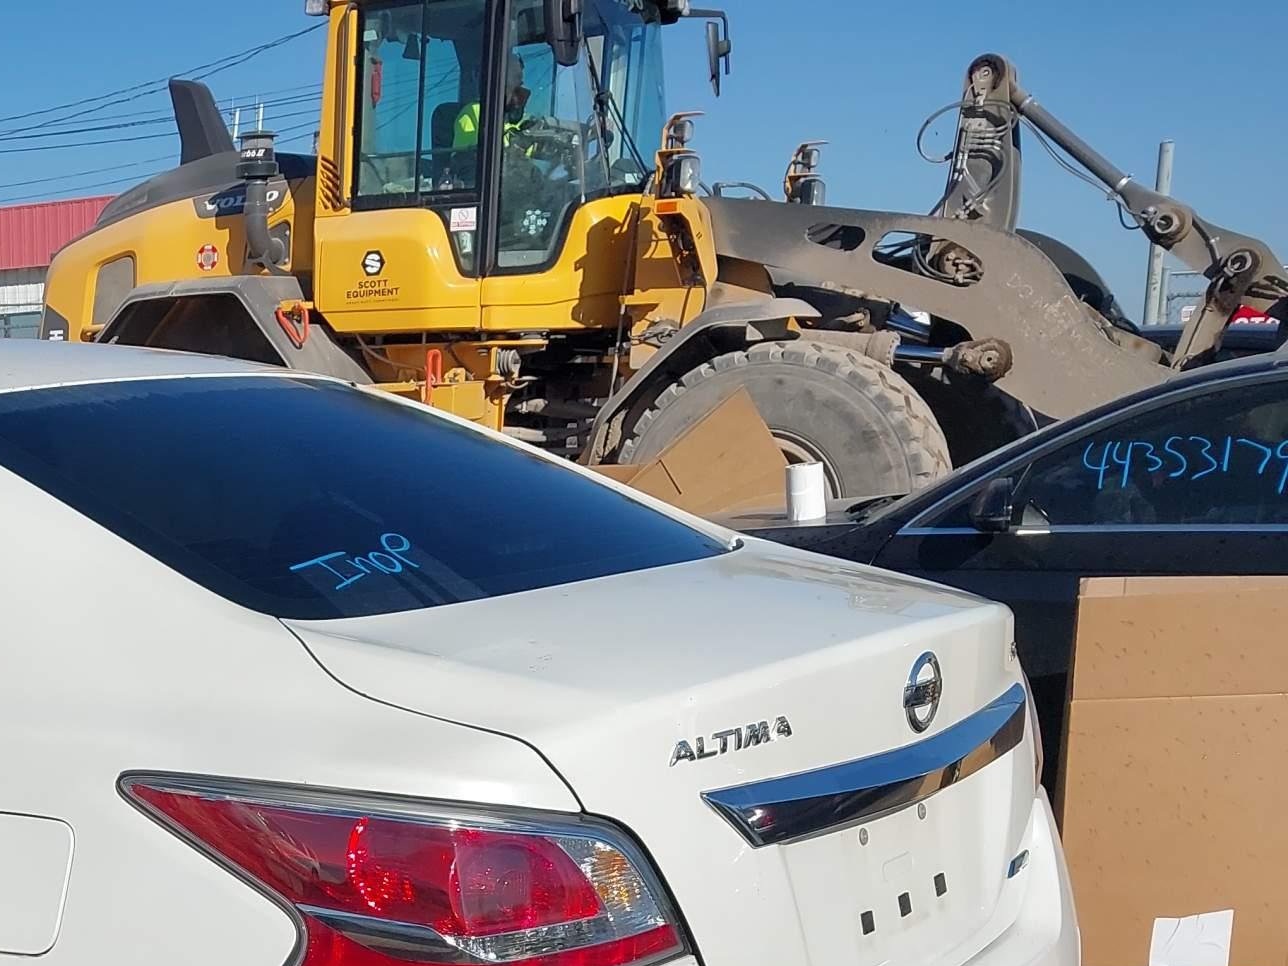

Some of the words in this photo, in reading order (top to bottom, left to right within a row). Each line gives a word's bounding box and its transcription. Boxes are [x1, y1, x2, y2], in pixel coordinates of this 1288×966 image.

[204, 190, 280, 210] VOLO
[358, 279, 388, 289] SCOTT
[346, 287, 400, 299] EQUIPMENT
[669, 715, 793, 767] ALTIMA
